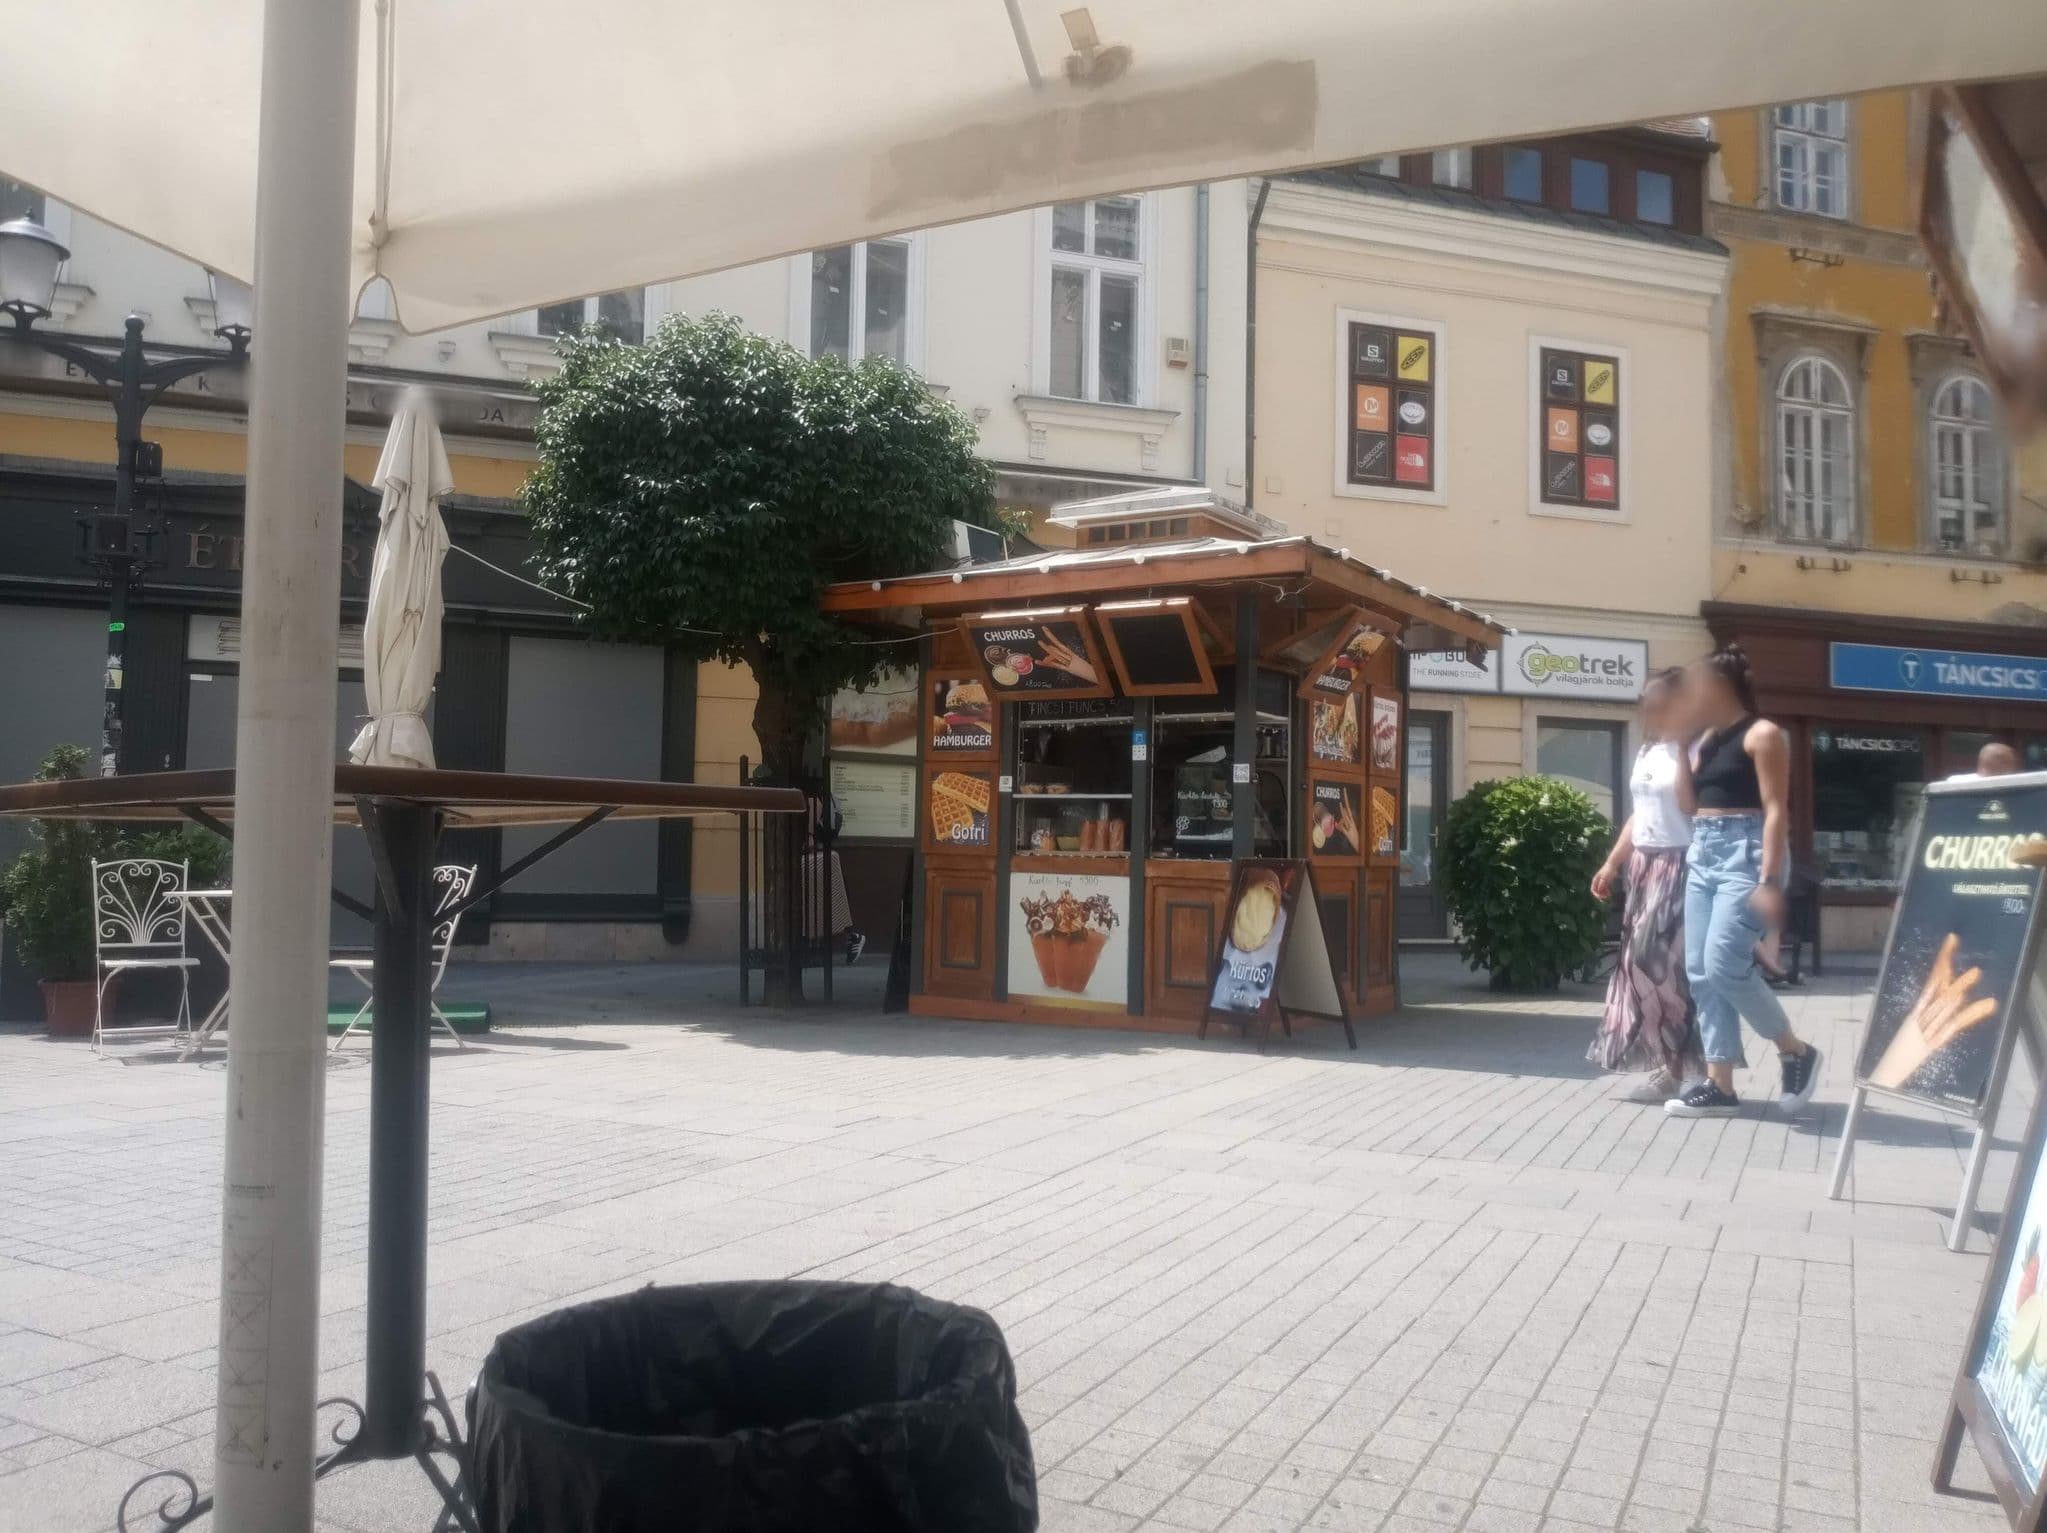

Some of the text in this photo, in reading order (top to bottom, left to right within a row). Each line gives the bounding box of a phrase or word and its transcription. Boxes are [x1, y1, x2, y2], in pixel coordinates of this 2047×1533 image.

[983, 628, 1036, 642] CHURROS
[1527, 652, 1634, 677] geotrek
[1427, 668, 1459, 678] RUNNING
[1316, 674, 1352, 692] HAMBURGER
[1606, 676, 1634, 688] boltja
[933, 734, 992, 747] HAMBURGER
[1316, 786, 1341, 800] CHURROS
[951, 822, 985, 841] Gofri
